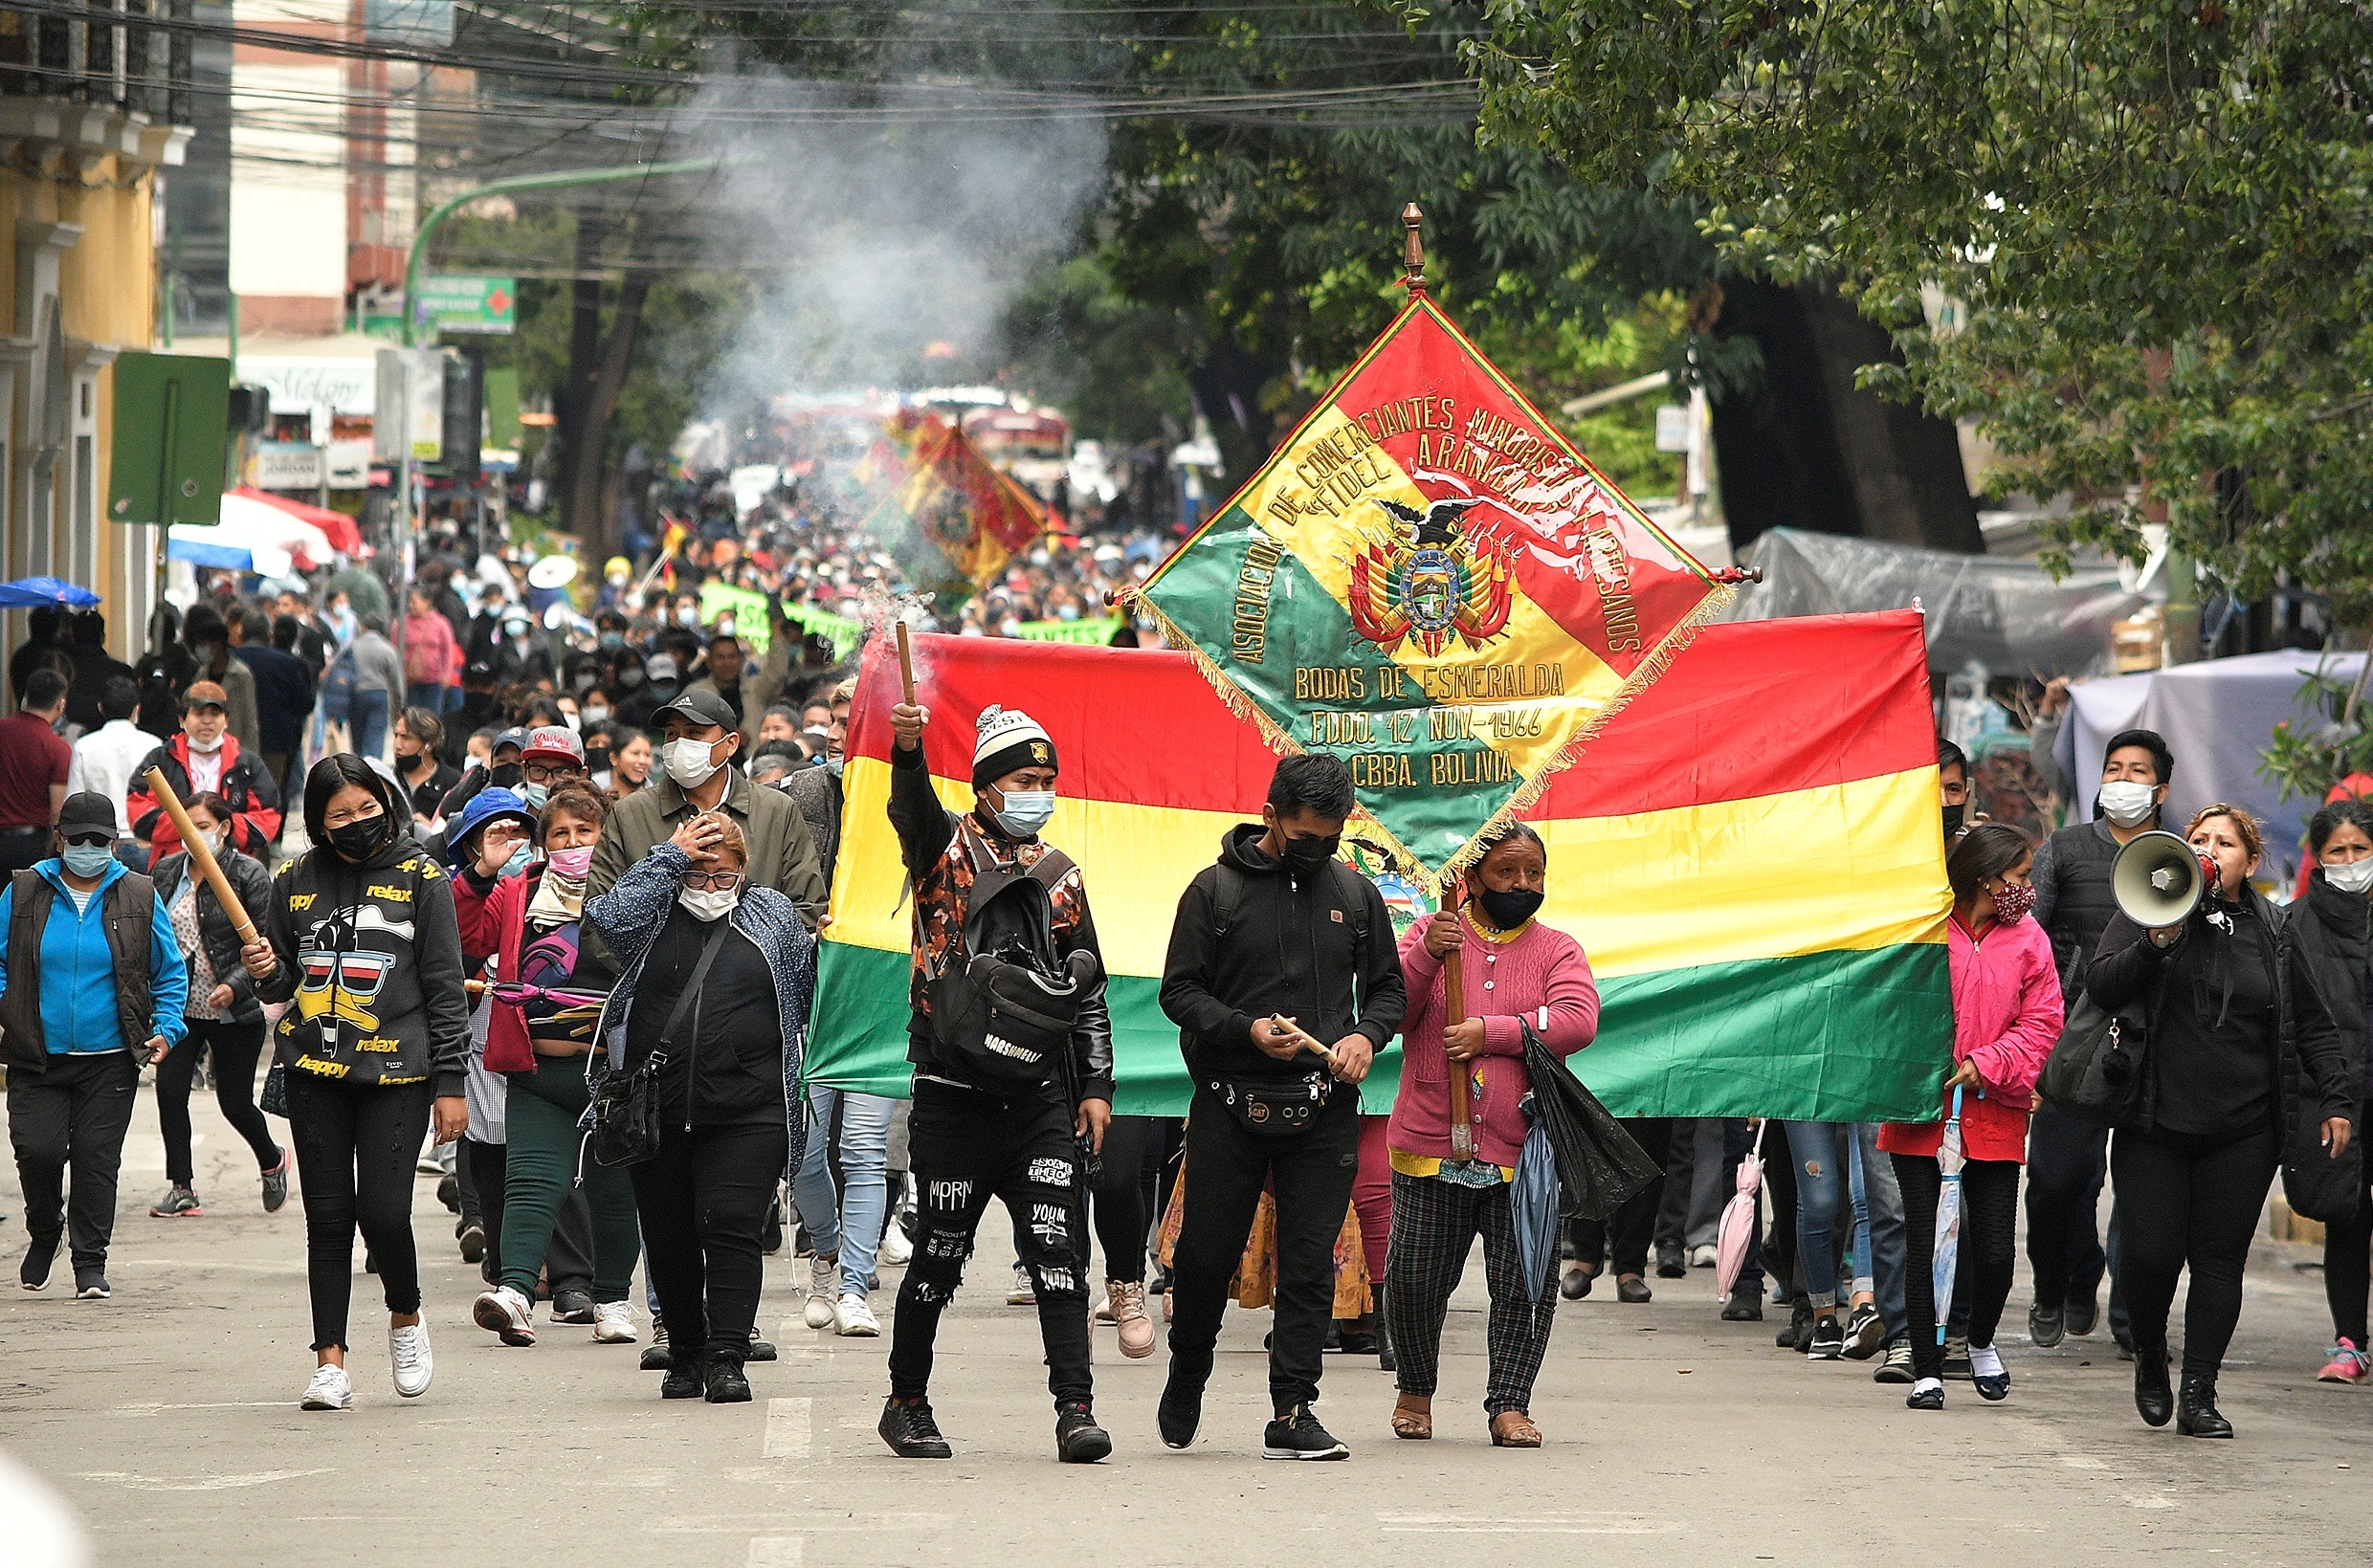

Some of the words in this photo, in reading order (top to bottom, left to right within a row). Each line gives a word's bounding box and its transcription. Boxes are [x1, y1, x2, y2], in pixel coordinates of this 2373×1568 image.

[1231, 537, 1283, 664] ASOCIACION
[1268, 486, 1307, 527] DE
[1296, 395, 1455, 490] COMERCIANTES
[1464, 407, 1585, 508] MINORISTAS
[1580, 526, 1642, 653] ARTESANOS
[1295, 666, 1365, 700] BODAS
[1378, 666, 1409, 700] DE
[1423, 663, 1565, 700] ESMERALDA
[1311, 711, 1376, 744] FDDO.
[1386, 711, 1414, 743] 12
[1351, 753, 1418, 787] CBBA.
[1430, 750, 1515, 785] BOLIVIA
[366, 884, 412, 903] relax
[355, 1035, 400, 1053] relax
[294, 1054, 352, 1079] happy
[1253, 1108, 1266, 1118] CAT
